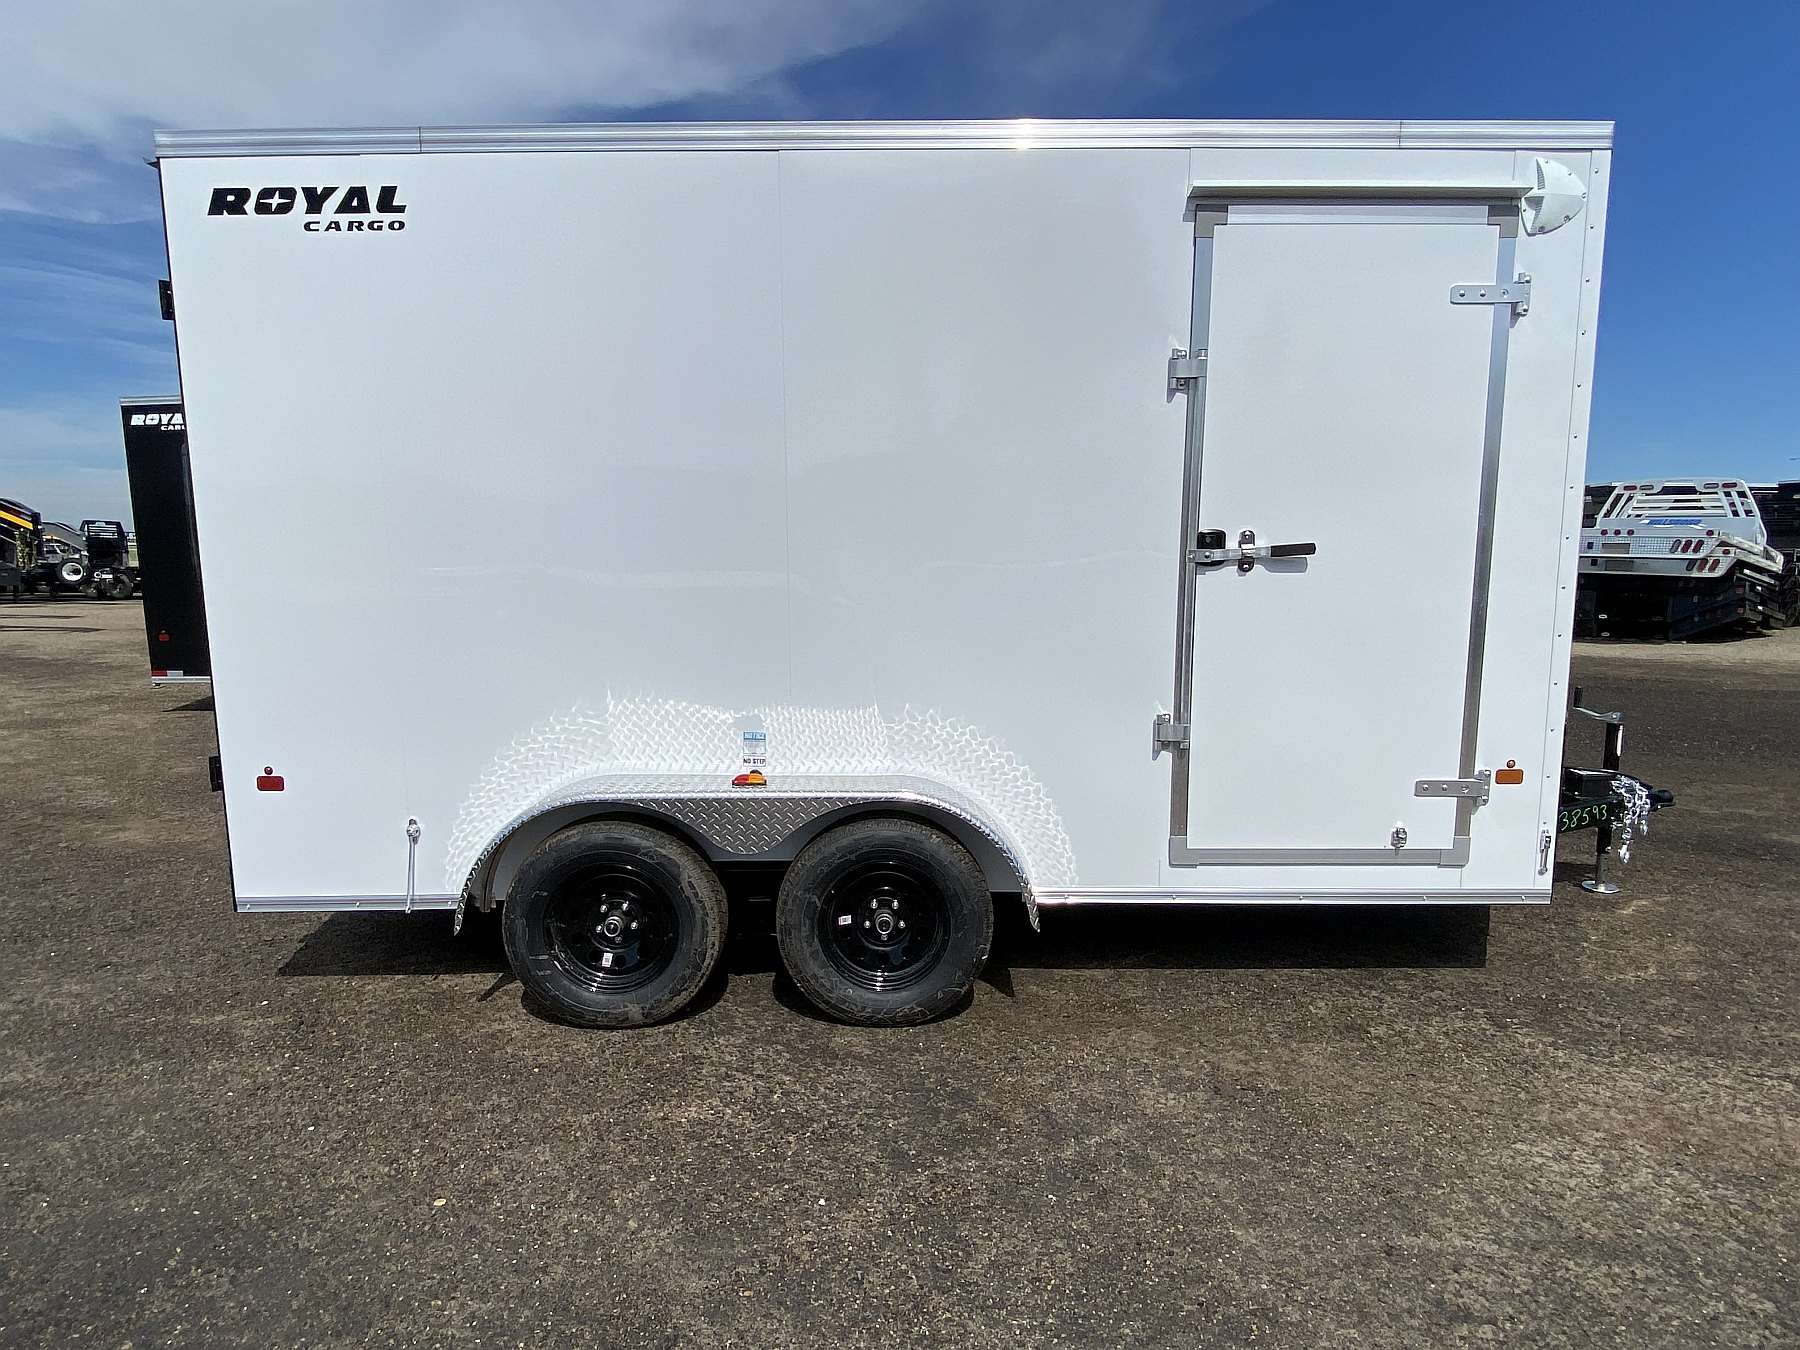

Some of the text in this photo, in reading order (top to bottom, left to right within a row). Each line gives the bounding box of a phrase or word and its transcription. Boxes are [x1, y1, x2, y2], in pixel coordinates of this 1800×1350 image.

[207, 185, 408, 216] ROYAL
[303, 220, 407, 232] CARGO
[1558, 804, 1607, 831] 38593
